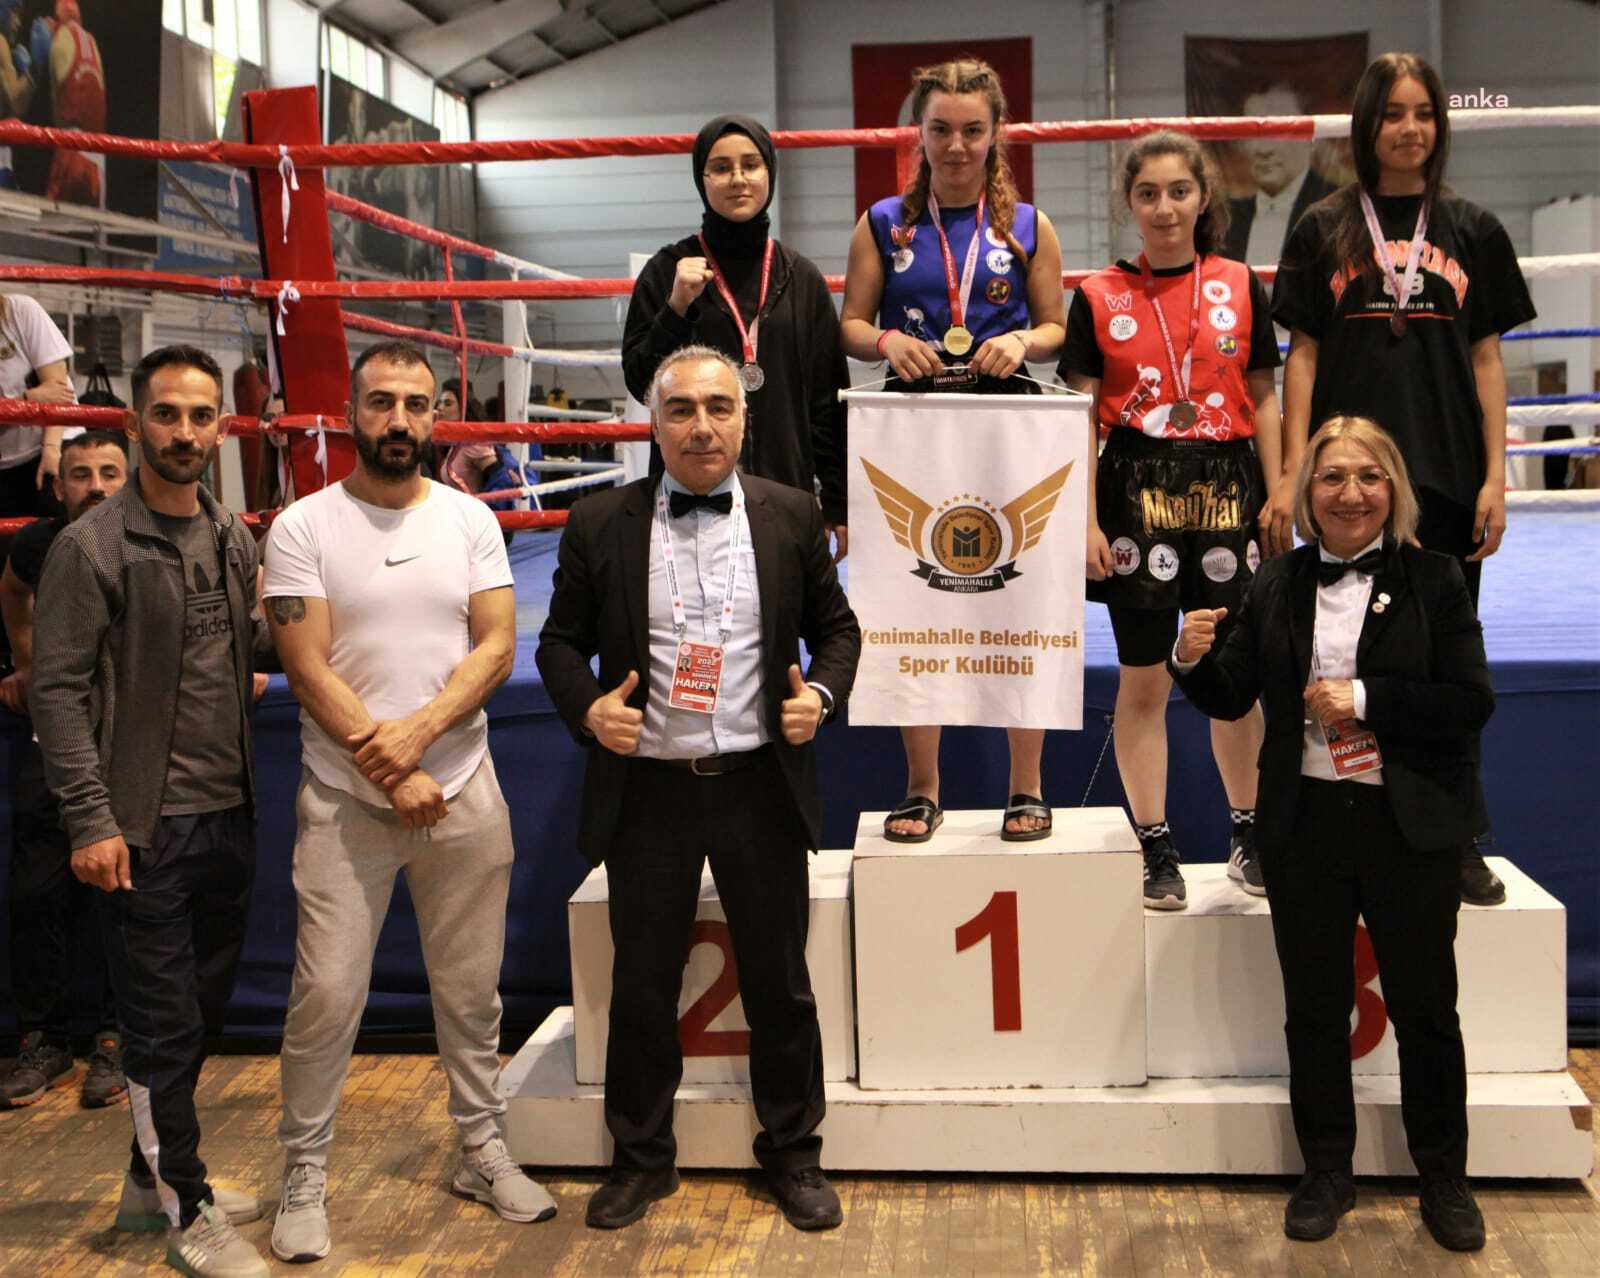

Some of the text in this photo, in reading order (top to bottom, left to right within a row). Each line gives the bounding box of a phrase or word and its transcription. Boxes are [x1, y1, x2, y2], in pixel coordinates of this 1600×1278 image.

[899, 655, 1033, 676] Spor Kulübü
[980, 630, 1078, 650] Belediyesi
[678, 920, 751, 1057] 2
[956, 891, 1021, 1032] 1
